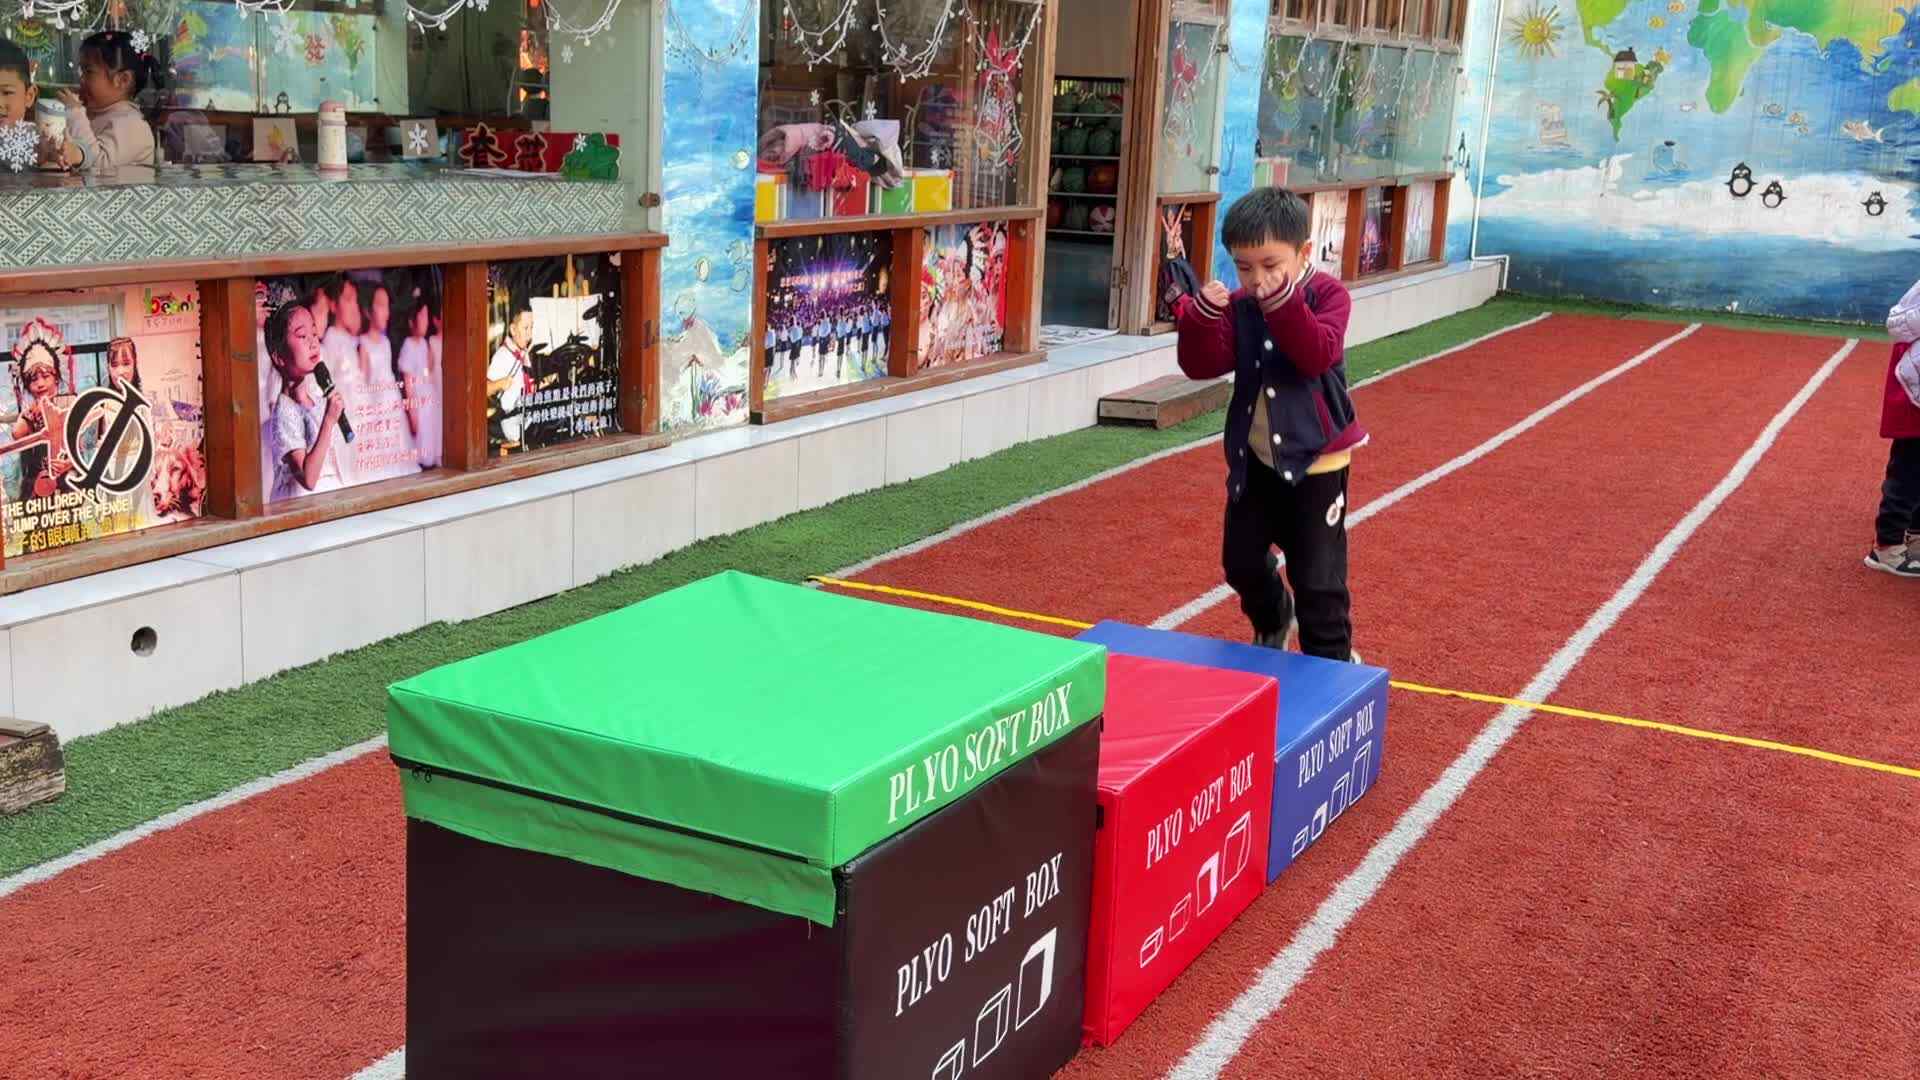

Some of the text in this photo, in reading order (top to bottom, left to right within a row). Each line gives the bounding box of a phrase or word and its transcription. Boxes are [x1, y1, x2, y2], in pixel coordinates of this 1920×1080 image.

[2, 501, 24, 517] THE
[10, 516, 38, 533] JUMP
[41, 511, 70, 527] OVER
[73, 506, 93, 521] THE
[888, 682, 1073, 824] PLYO SOFT BOX
[1297, 700, 1375, 788] PLYO SOFT BOX
[1146, 752, 1255, 869] PLYO SOFT BOX
[894, 852, 1063, 1017] PLYO SOFT BOX
